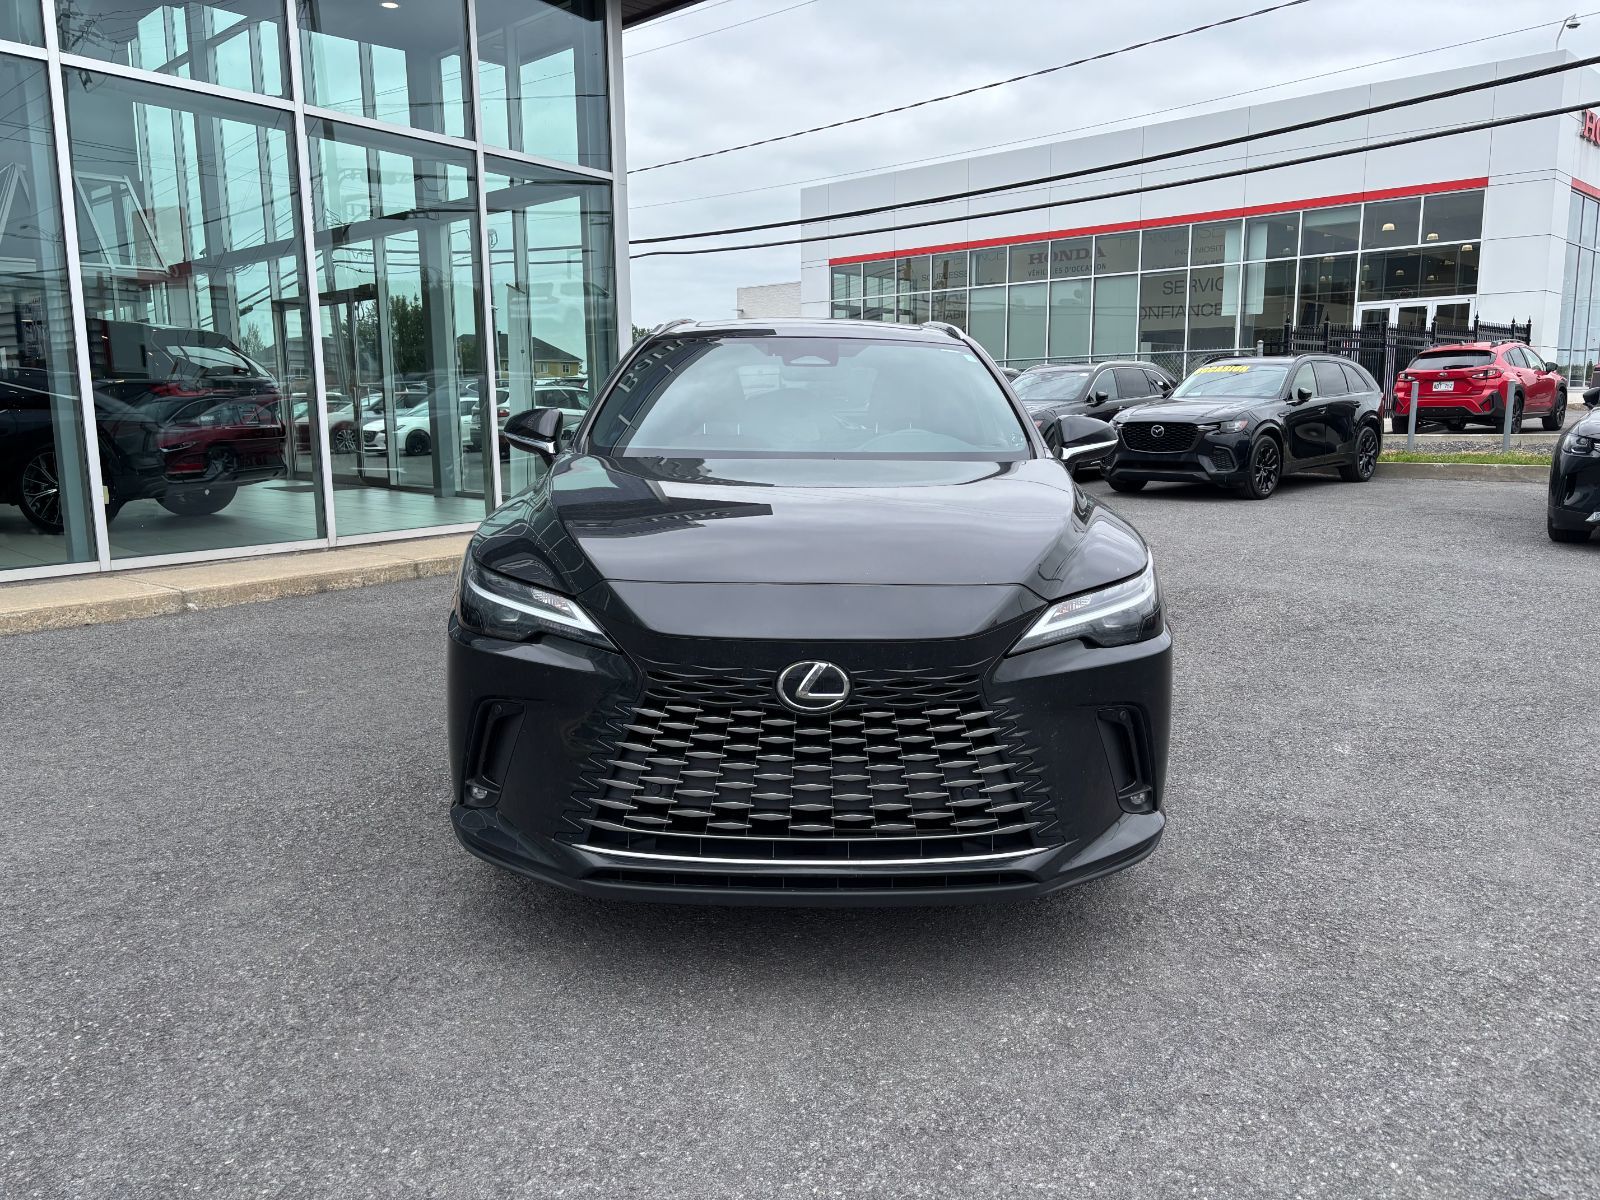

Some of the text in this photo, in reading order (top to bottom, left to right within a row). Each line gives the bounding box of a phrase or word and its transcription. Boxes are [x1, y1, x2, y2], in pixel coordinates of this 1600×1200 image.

[1028, 246, 1107, 265] HONDA
[1028, 263, 1106, 277] VÉHICES D'OCCASON
